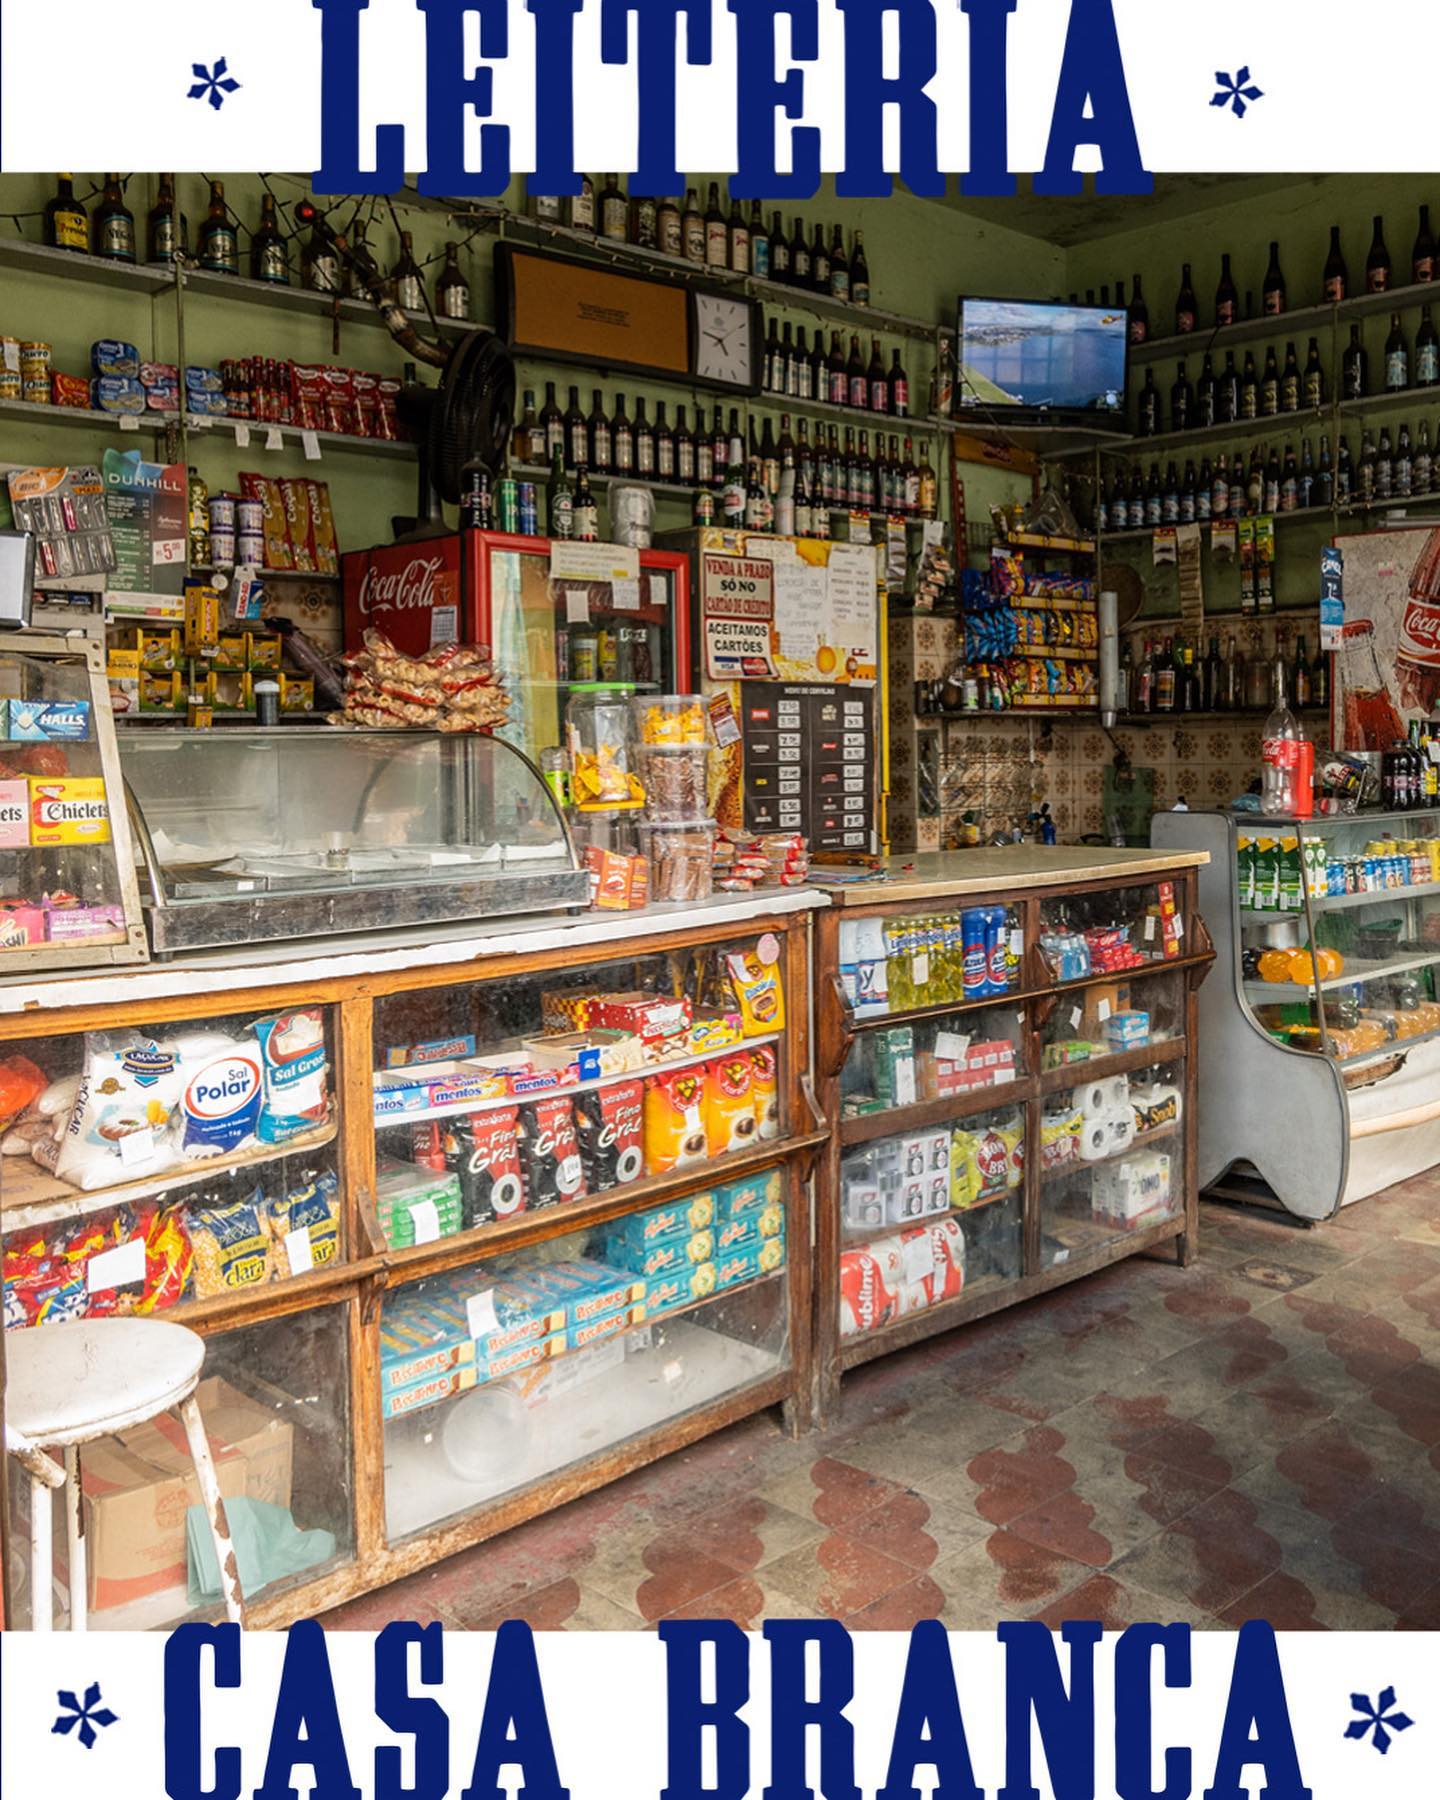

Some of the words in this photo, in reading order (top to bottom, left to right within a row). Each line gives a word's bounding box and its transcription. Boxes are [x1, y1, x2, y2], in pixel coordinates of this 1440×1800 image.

[108, 472, 182, 492] DUNHILL
[706, 559, 735, 575] VENDA
[737, 561, 743, 577] A
[744, 562, 770, 579] PRAZO
[359, 557, 443, 614] Coca-Cola
[720, 578, 736, 591] SÓ
[738, 581, 756, 593] NO
[734, 597, 742, 614] DE
[708, 622, 767, 637] ACEITAMOS
[714, 637, 763, 653] CARTÕES
[40, 713, 85, 726] HALLS
[47, 801, 108, 821] Chiclets
[229, 1067, 248, 1082] Sal
[275, 1066, 296, 1082] Sal
[196, 1077, 251, 1103] Polar
[515, 1075, 557, 1092] mentos
[435, 1086, 482, 1102] mentos
[376, 1099, 404, 1111] ntos
[226, 1259, 266, 1287] clara
[859, 1256, 874, 1328] ublime
